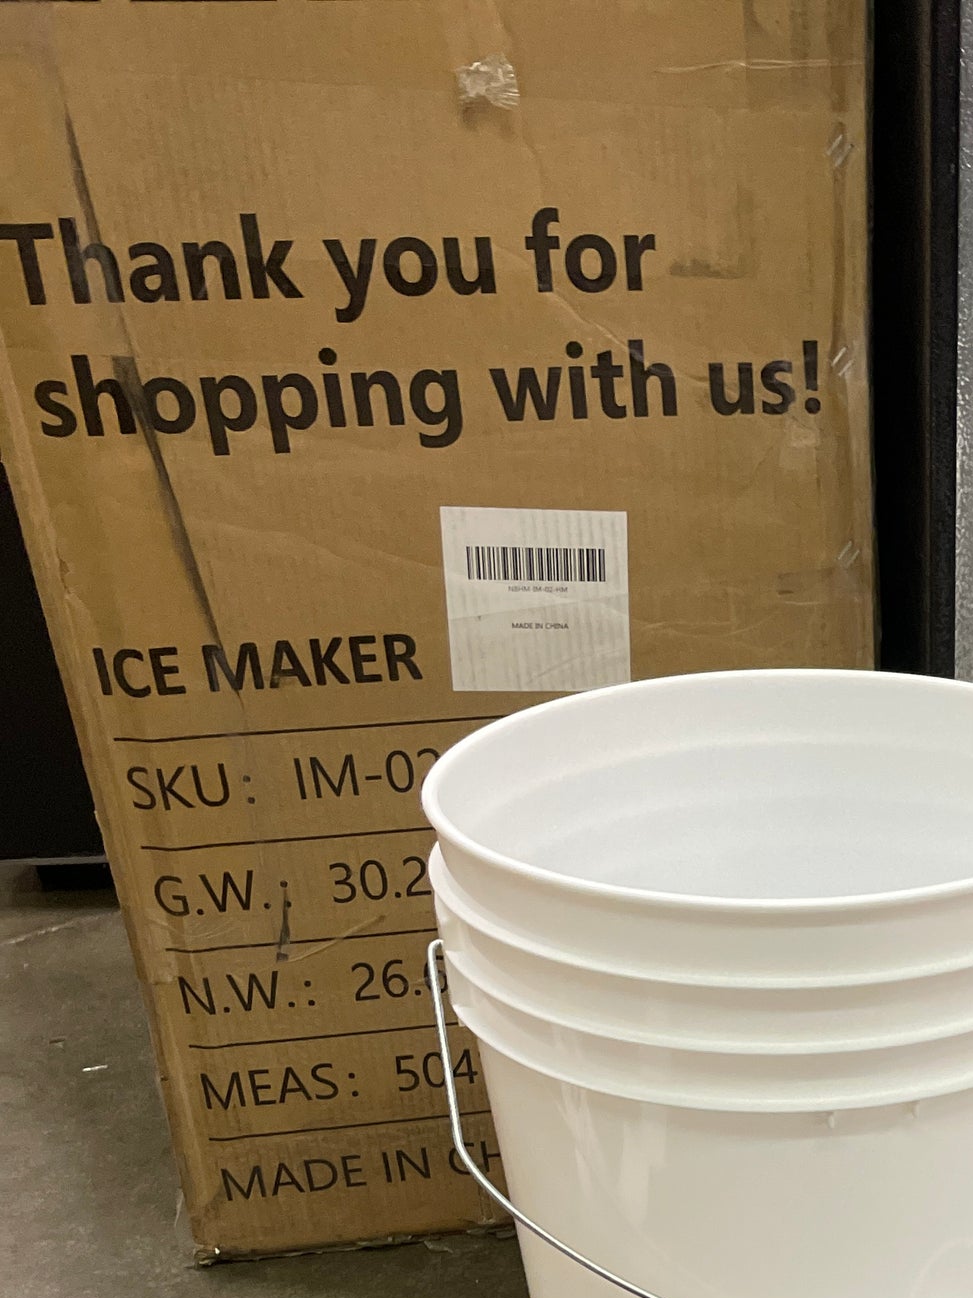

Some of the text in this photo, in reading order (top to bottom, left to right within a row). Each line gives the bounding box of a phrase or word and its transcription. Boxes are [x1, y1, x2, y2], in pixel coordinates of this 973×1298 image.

[0, 207, 657, 323] Thank you for
[34, 337, 823, 456] shopping with us!
[511, 622, 569, 630] MADE IN CHINA
[92, 633, 424, 698] ICE MAKER
[328, 855, 433, 906] 30.2
[178, 969, 317, 1016] N.W.:
[200, 1048, 479, 1112] MEAS: 504
[220, 1154, 368, 1202] MADE
[382, 1147, 431, 1184] IN
